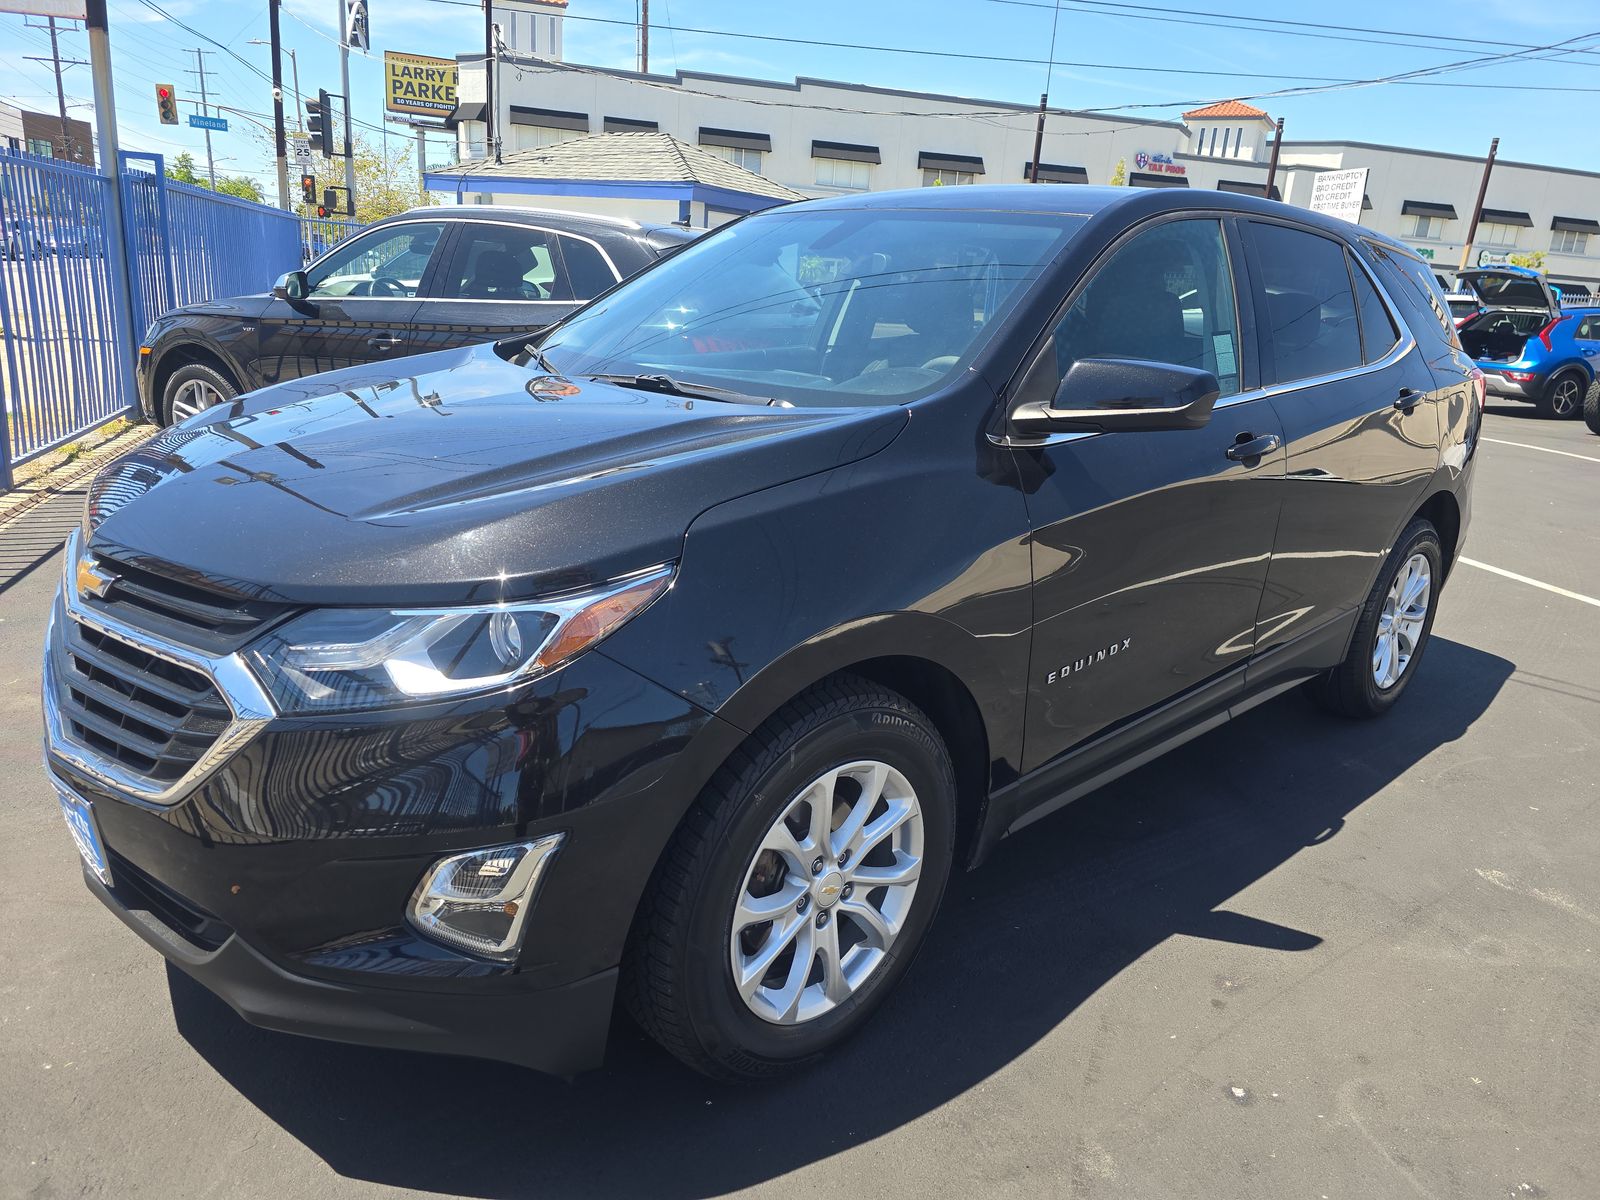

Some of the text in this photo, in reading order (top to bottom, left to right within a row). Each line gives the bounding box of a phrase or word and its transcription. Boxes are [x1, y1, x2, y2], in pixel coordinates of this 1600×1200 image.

[391, 63, 446, 83] LARRY
[191, 117, 226, 129] Vineland
[296, 148, 310, 157] 25
[1148, 163, 1164, 172] TAX
[1317, 171, 1364, 182] BANKRUPTCY
[1316, 181, 1357, 192] BAD CREDIT
[1325, 191, 1352, 201] CREDIT
[1341, 200, 1360, 209] BUYER
[1047, 637, 1131, 685] EQUINOX
